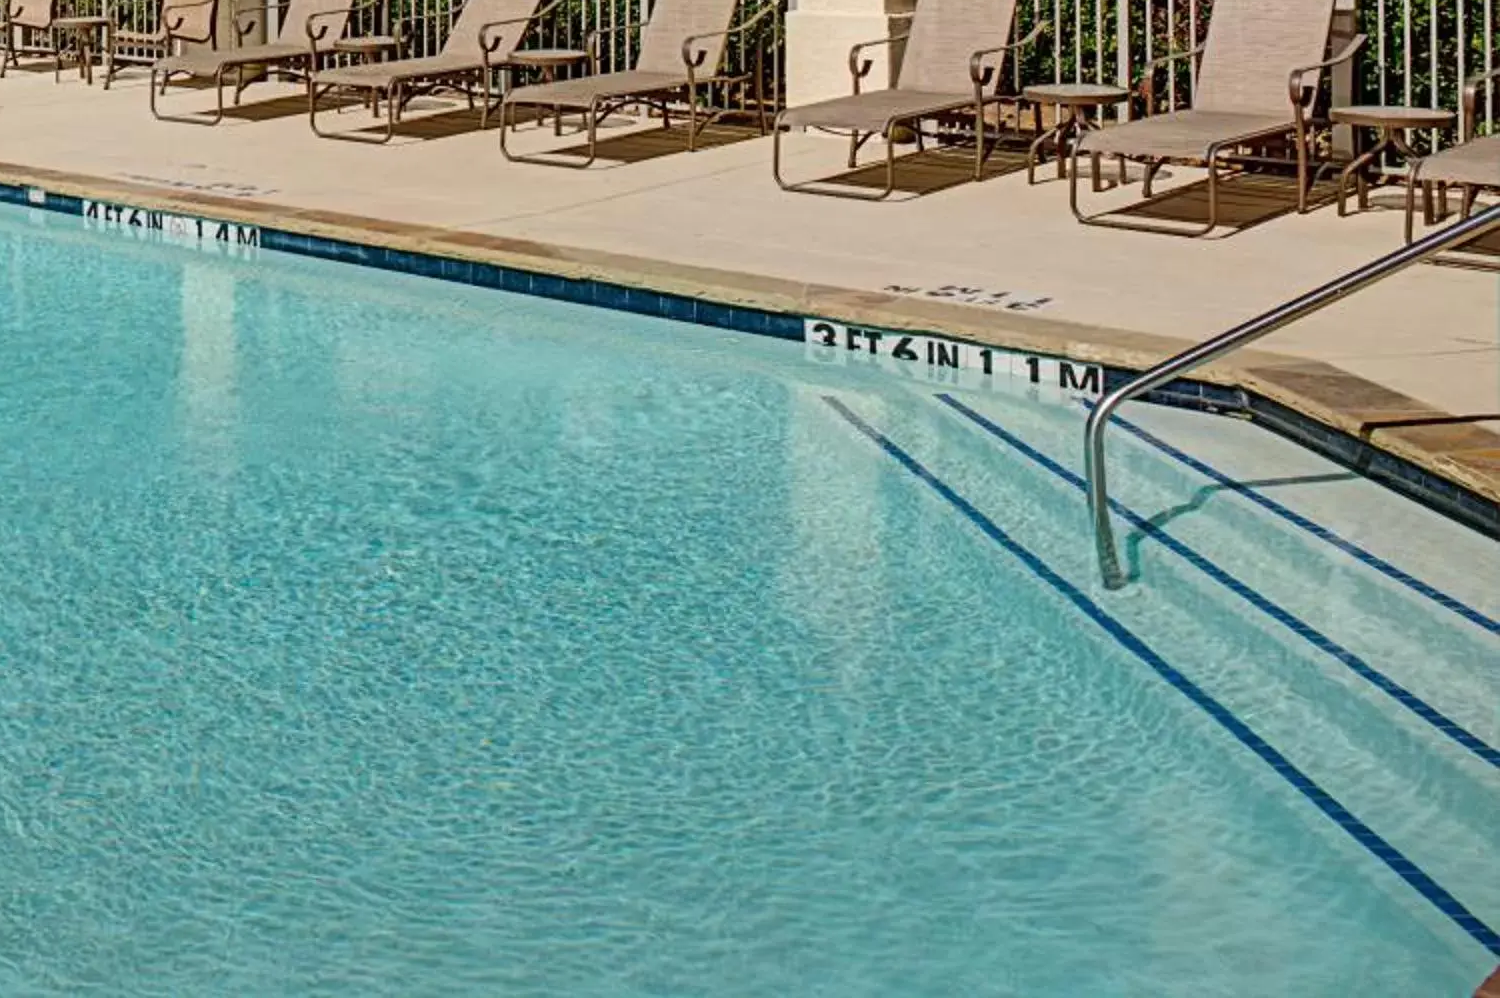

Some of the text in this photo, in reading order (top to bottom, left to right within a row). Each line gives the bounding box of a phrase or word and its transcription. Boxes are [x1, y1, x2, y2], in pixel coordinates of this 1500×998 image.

[105, 205, 123, 223] FT
[146, 211, 163, 230] IN
[237, 225, 258, 247] M
[812, 322, 837, 347] 3
[846, 327, 882, 355] FT
[891, 337, 919, 361] 6
[927, 341, 959, 369] IN
[1059, 361, 1099, 394] M
